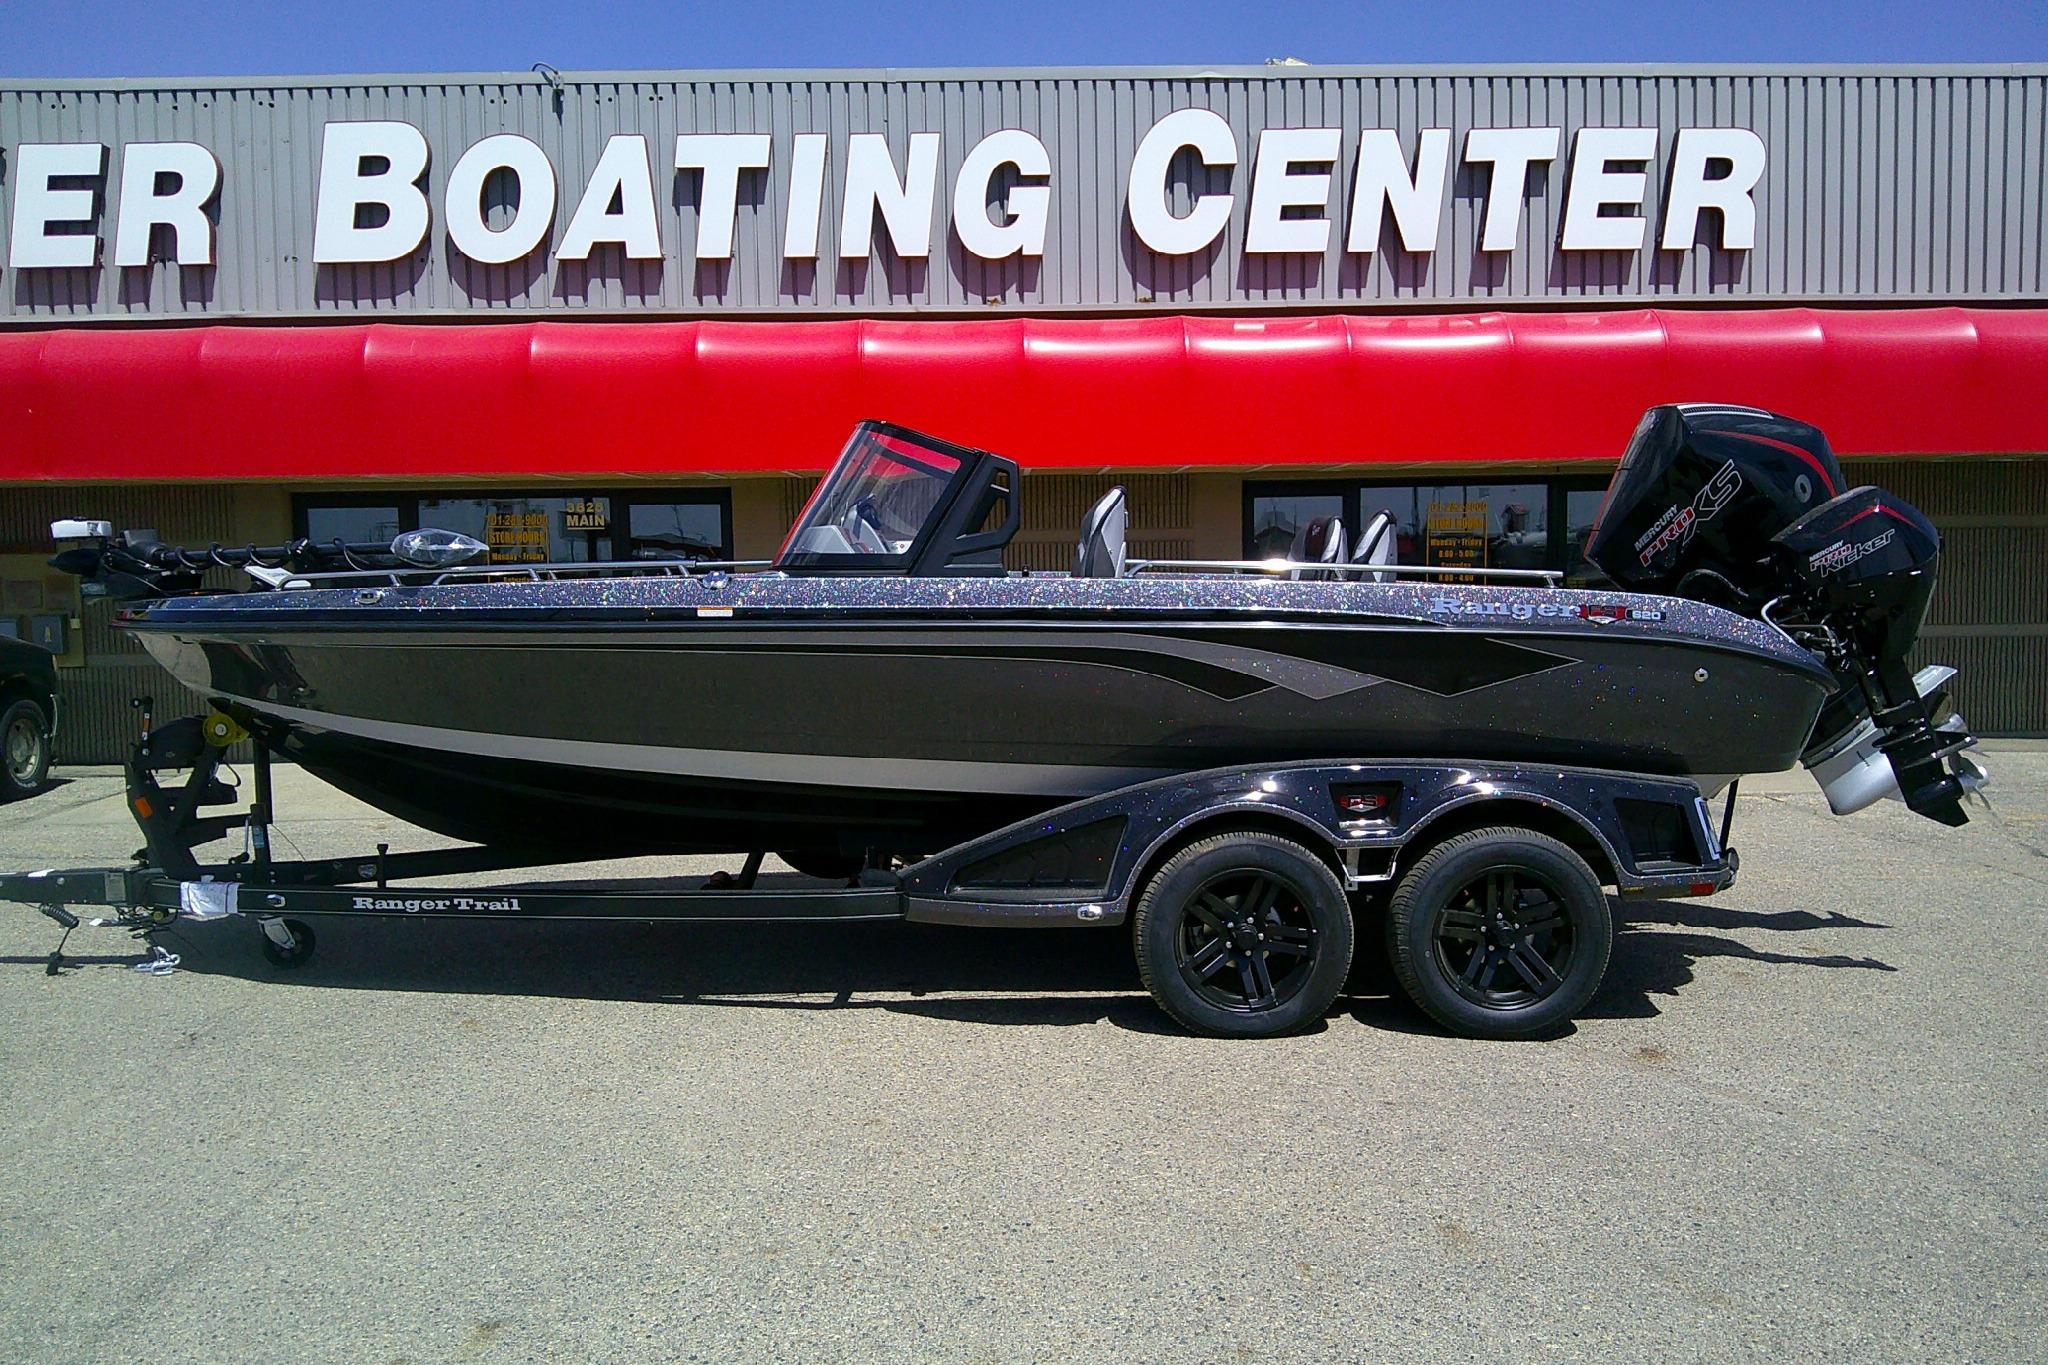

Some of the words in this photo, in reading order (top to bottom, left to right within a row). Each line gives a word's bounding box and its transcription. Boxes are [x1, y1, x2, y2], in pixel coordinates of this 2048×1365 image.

[313, 119, 1052, 264] BOATING
[1127, 107, 1768, 255] CENTER
[567, 514, 604, 527] MAIN
[1639, 506, 1696, 567] PRO
[1682, 459, 1743, 547] XS
[1634, 504, 1678, 551] MERCURY
[1809, 540, 1844, 562] MERCURY
[1430, 597, 1581, 620] Ranger
[1631, 610, 1662, 620] 620
[353, 896, 450, 913] Ranger
[453, 897, 522, 911] Trail
